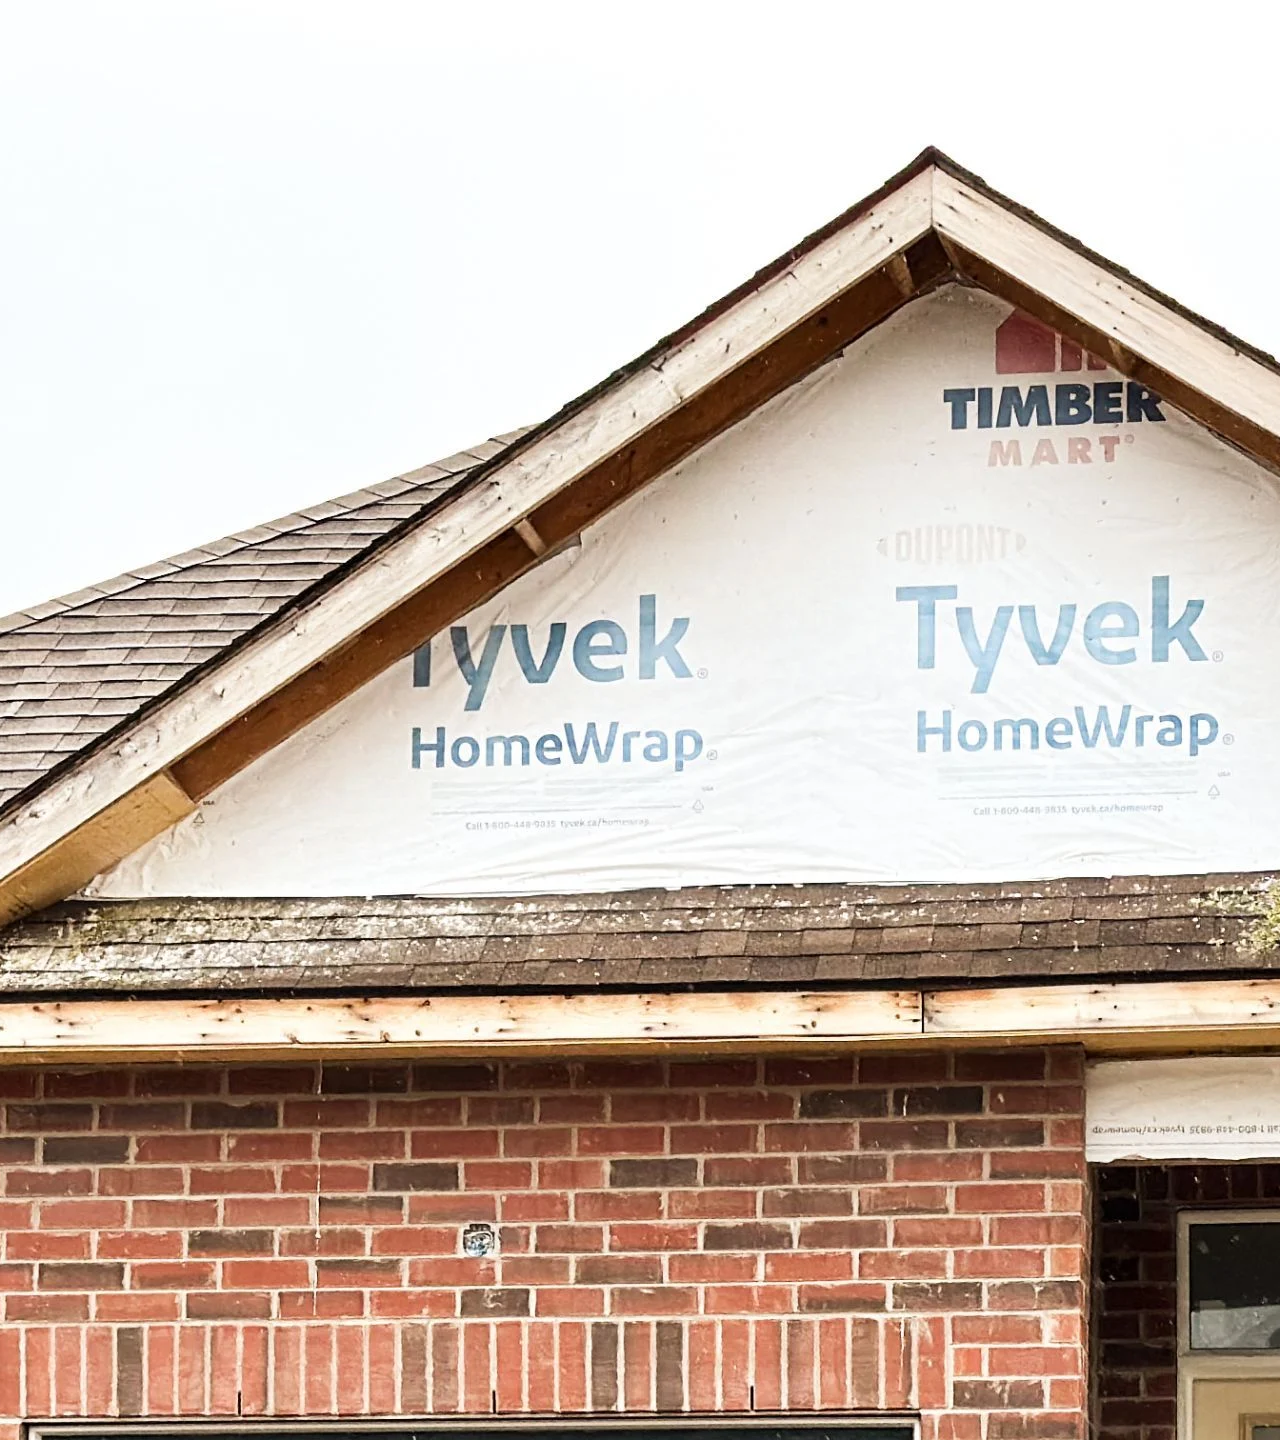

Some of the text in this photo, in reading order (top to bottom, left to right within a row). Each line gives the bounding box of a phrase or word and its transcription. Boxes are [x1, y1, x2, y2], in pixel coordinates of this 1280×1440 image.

[943, 381, 1166, 430] TIMBER
[988, 435, 1121, 468] MART
[895, 523, 1011, 566] DUPONT
[895, 575, 1209, 694] Tyvek
[411, 721, 704, 772] HomeWrap
[917, 704, 1220, 757] HomeWrap
[465, 821, 483, 831] Call
[973, 807, 990, 816] Call
